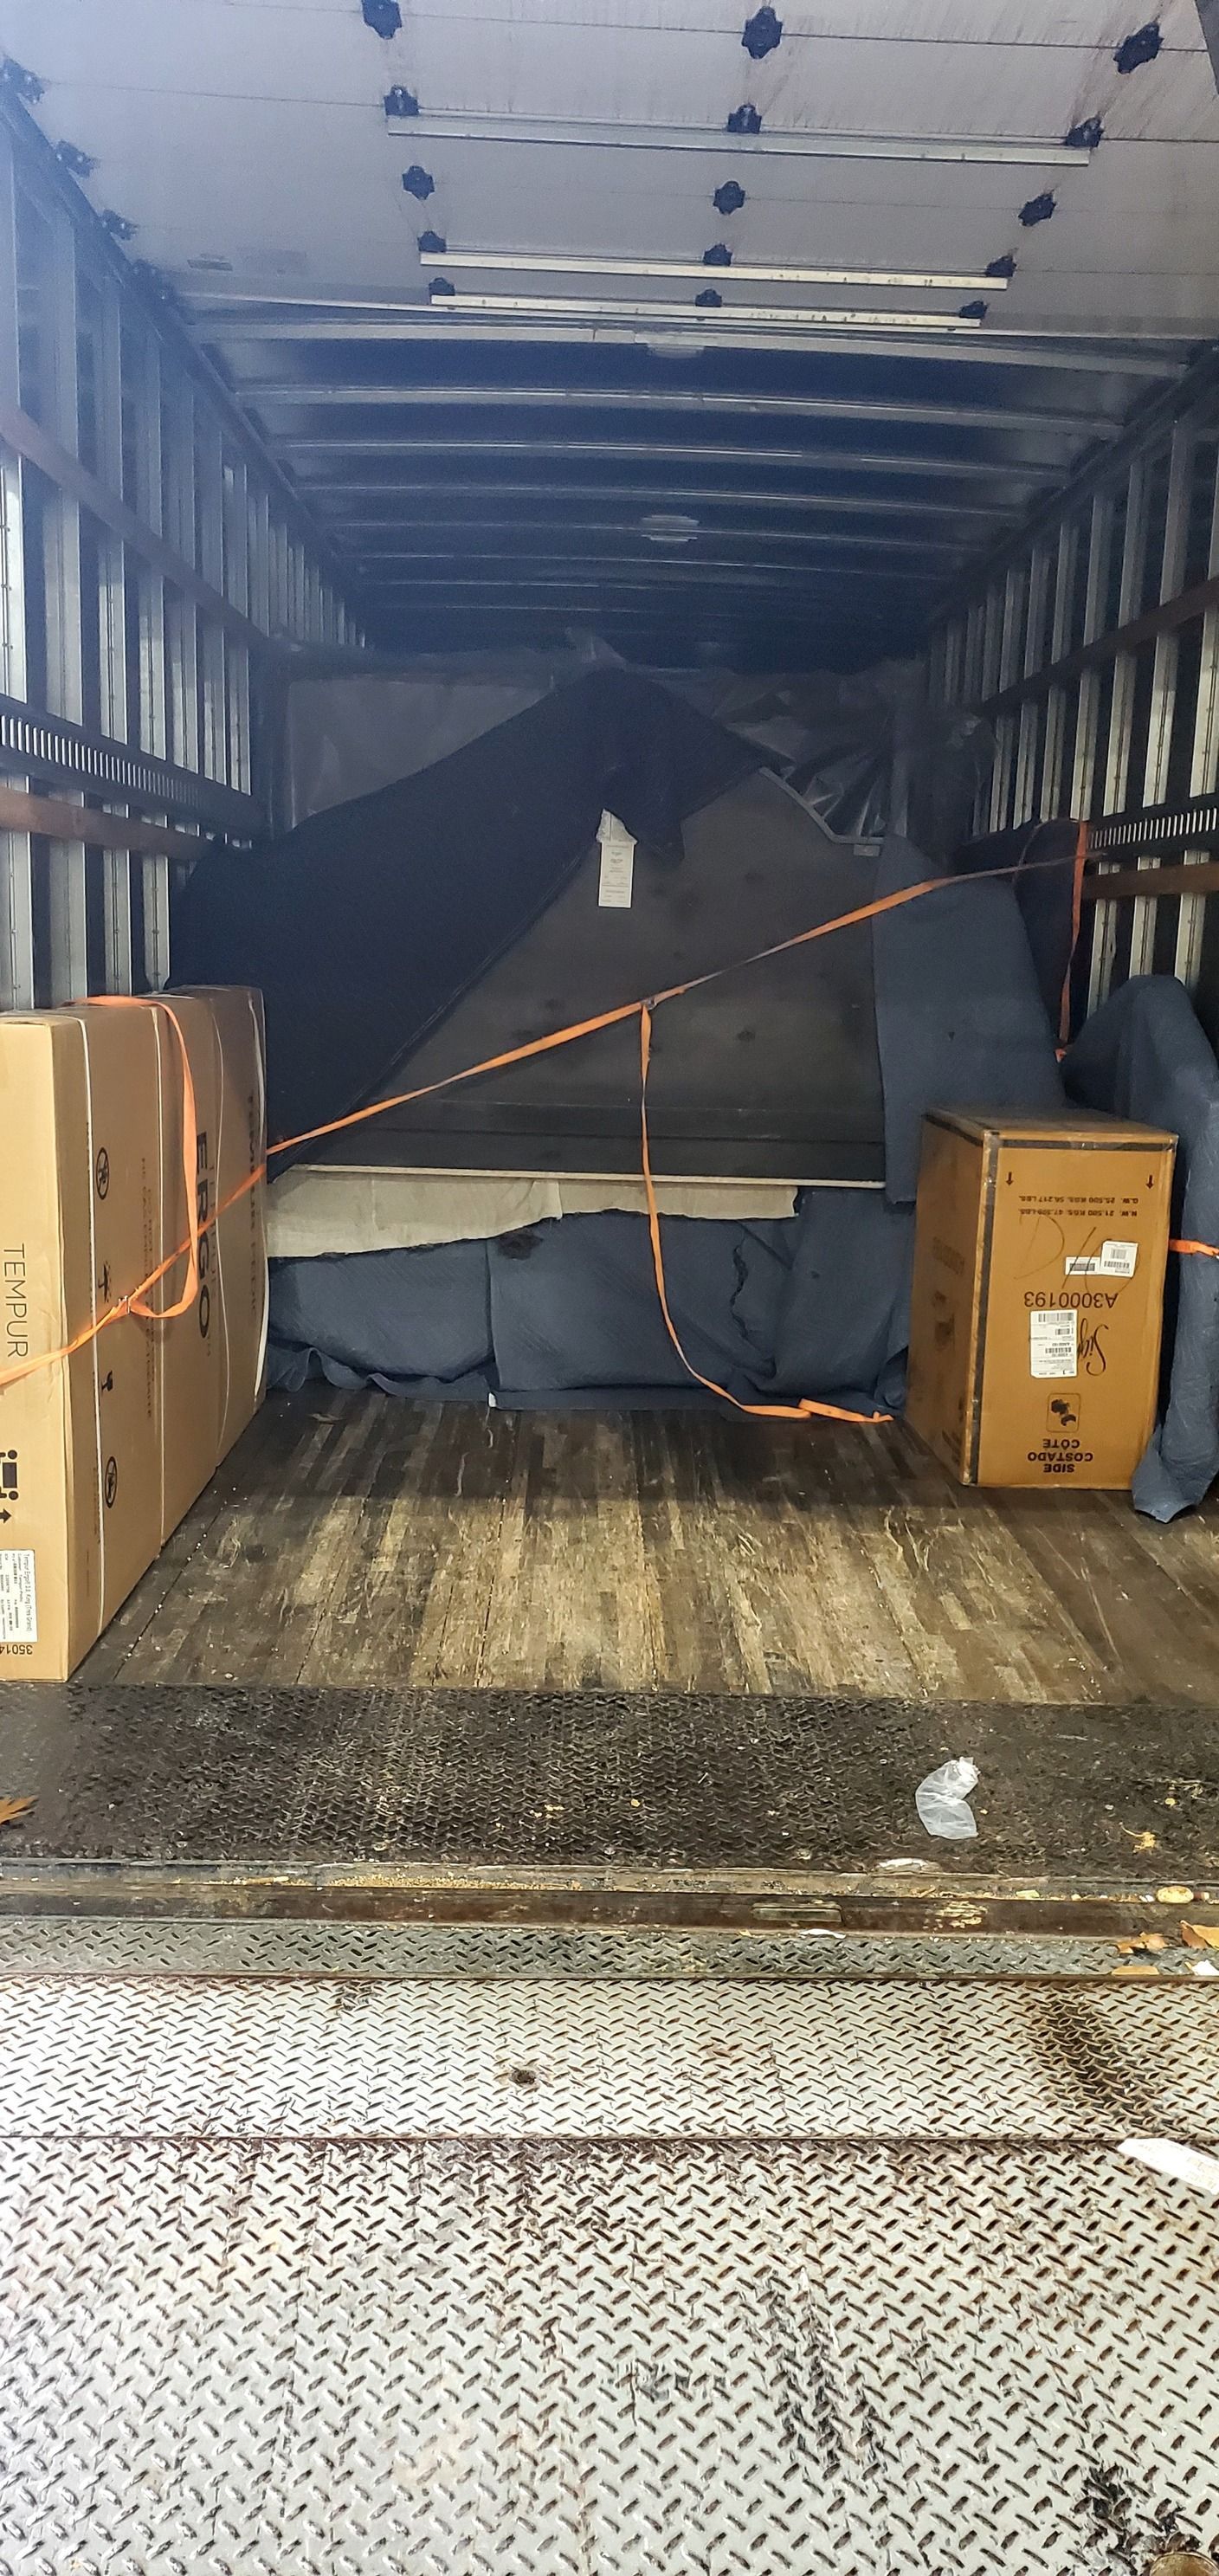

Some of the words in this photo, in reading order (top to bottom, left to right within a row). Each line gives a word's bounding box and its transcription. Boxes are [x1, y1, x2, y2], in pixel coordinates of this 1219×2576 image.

[197, 1131, 210, 1340] ERGO
[3, 1243, 29, 1358] TEMPUR
[1023, 1291, 1119, 1309] A3000193
[1076, 1317, 1109, 1377] Sig
[1027, 1451, 1093, 1462] COSTADO
[1042, 1463, 1075, 1474] SIDE
